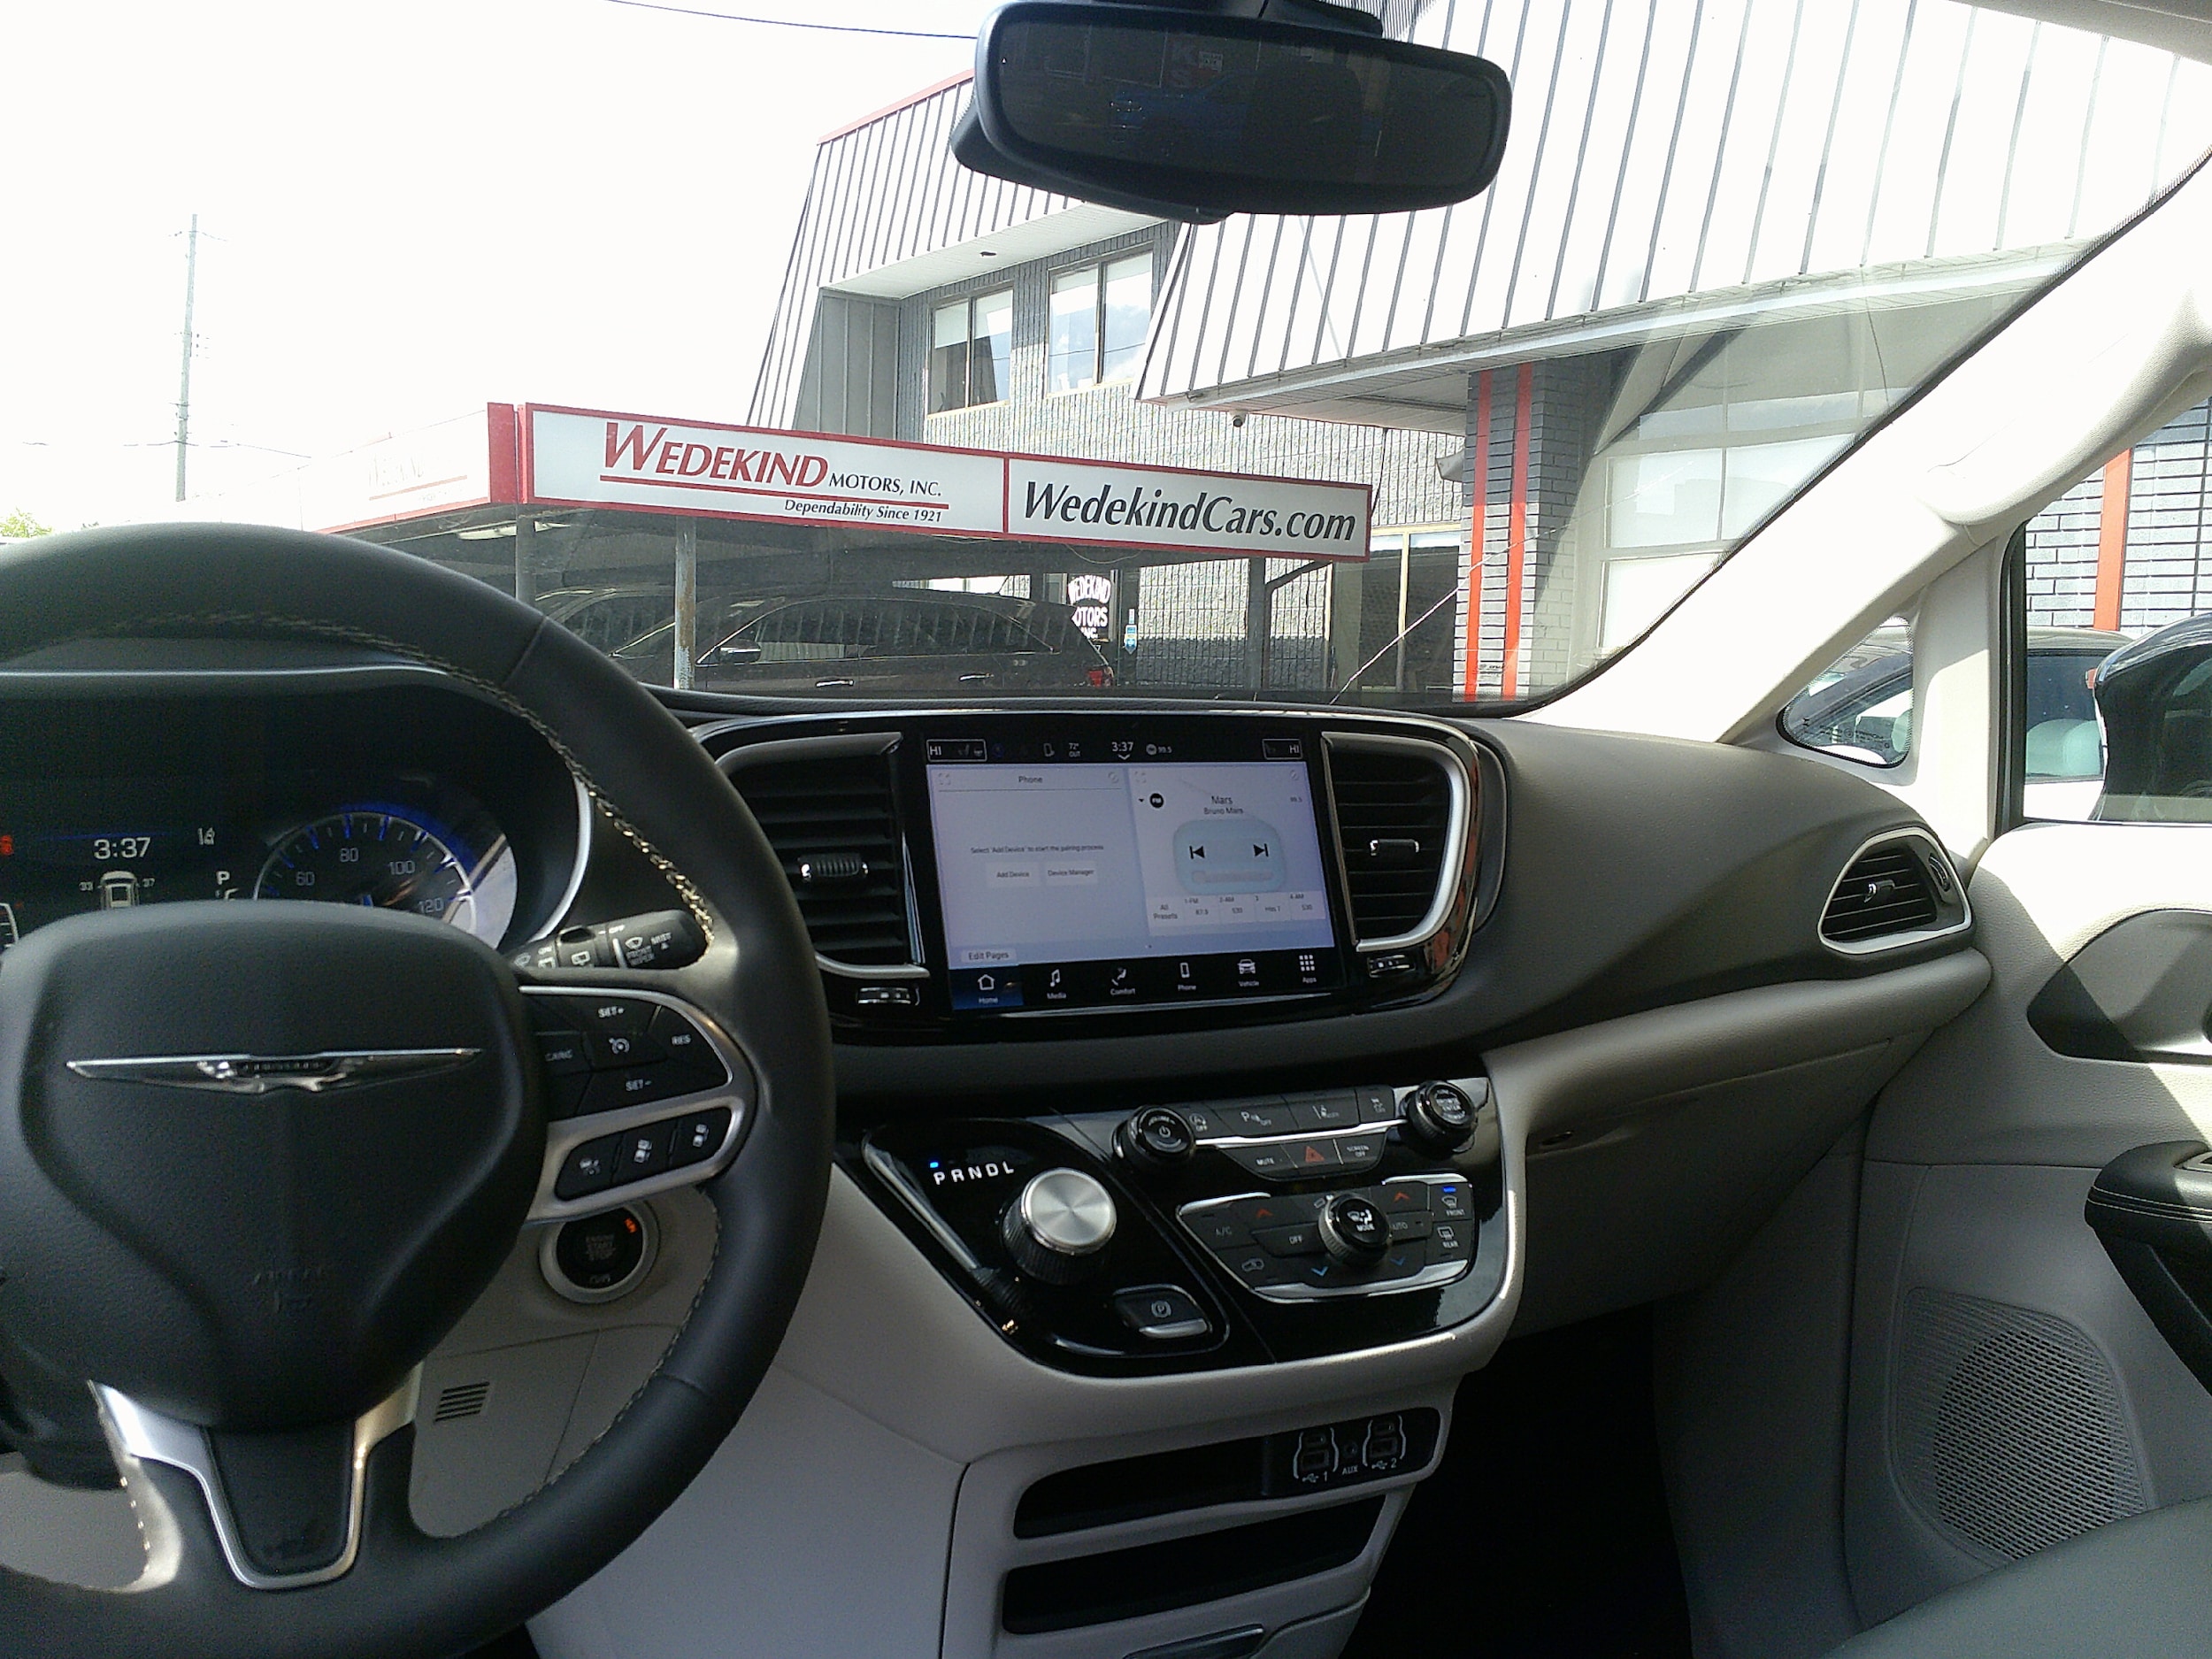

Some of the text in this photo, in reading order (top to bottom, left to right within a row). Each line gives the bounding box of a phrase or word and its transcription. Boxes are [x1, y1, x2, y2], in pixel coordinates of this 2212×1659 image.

[605, 422, 941, 496] WEDEKIND MOTORS, INC.
[785, 499, 941, 522] Dependability Since 1921
[1025, 481, 1356, 541] WedekindCars.com
[1068, 575, 1110, 605] WEDEKIND
[1071, 606, 1108, 627] OTORS
[930, 746, 941, 756] HI
[1112, 741, 1134, 752] 3:37
[94, 837, 150, 859] 3:37
[340, 848, 358, 862] 80
[388, 860, 415, 875] 100
[217, 871, 230, 885] P
[296, 872, 315, 886] 60
[418, 897, 443, 913] 120
[986, 952, 1009, 961] Pages
[1341, 1465, 1358, 1475] AUX
[1390, 1458, 1397, 1468] 2
